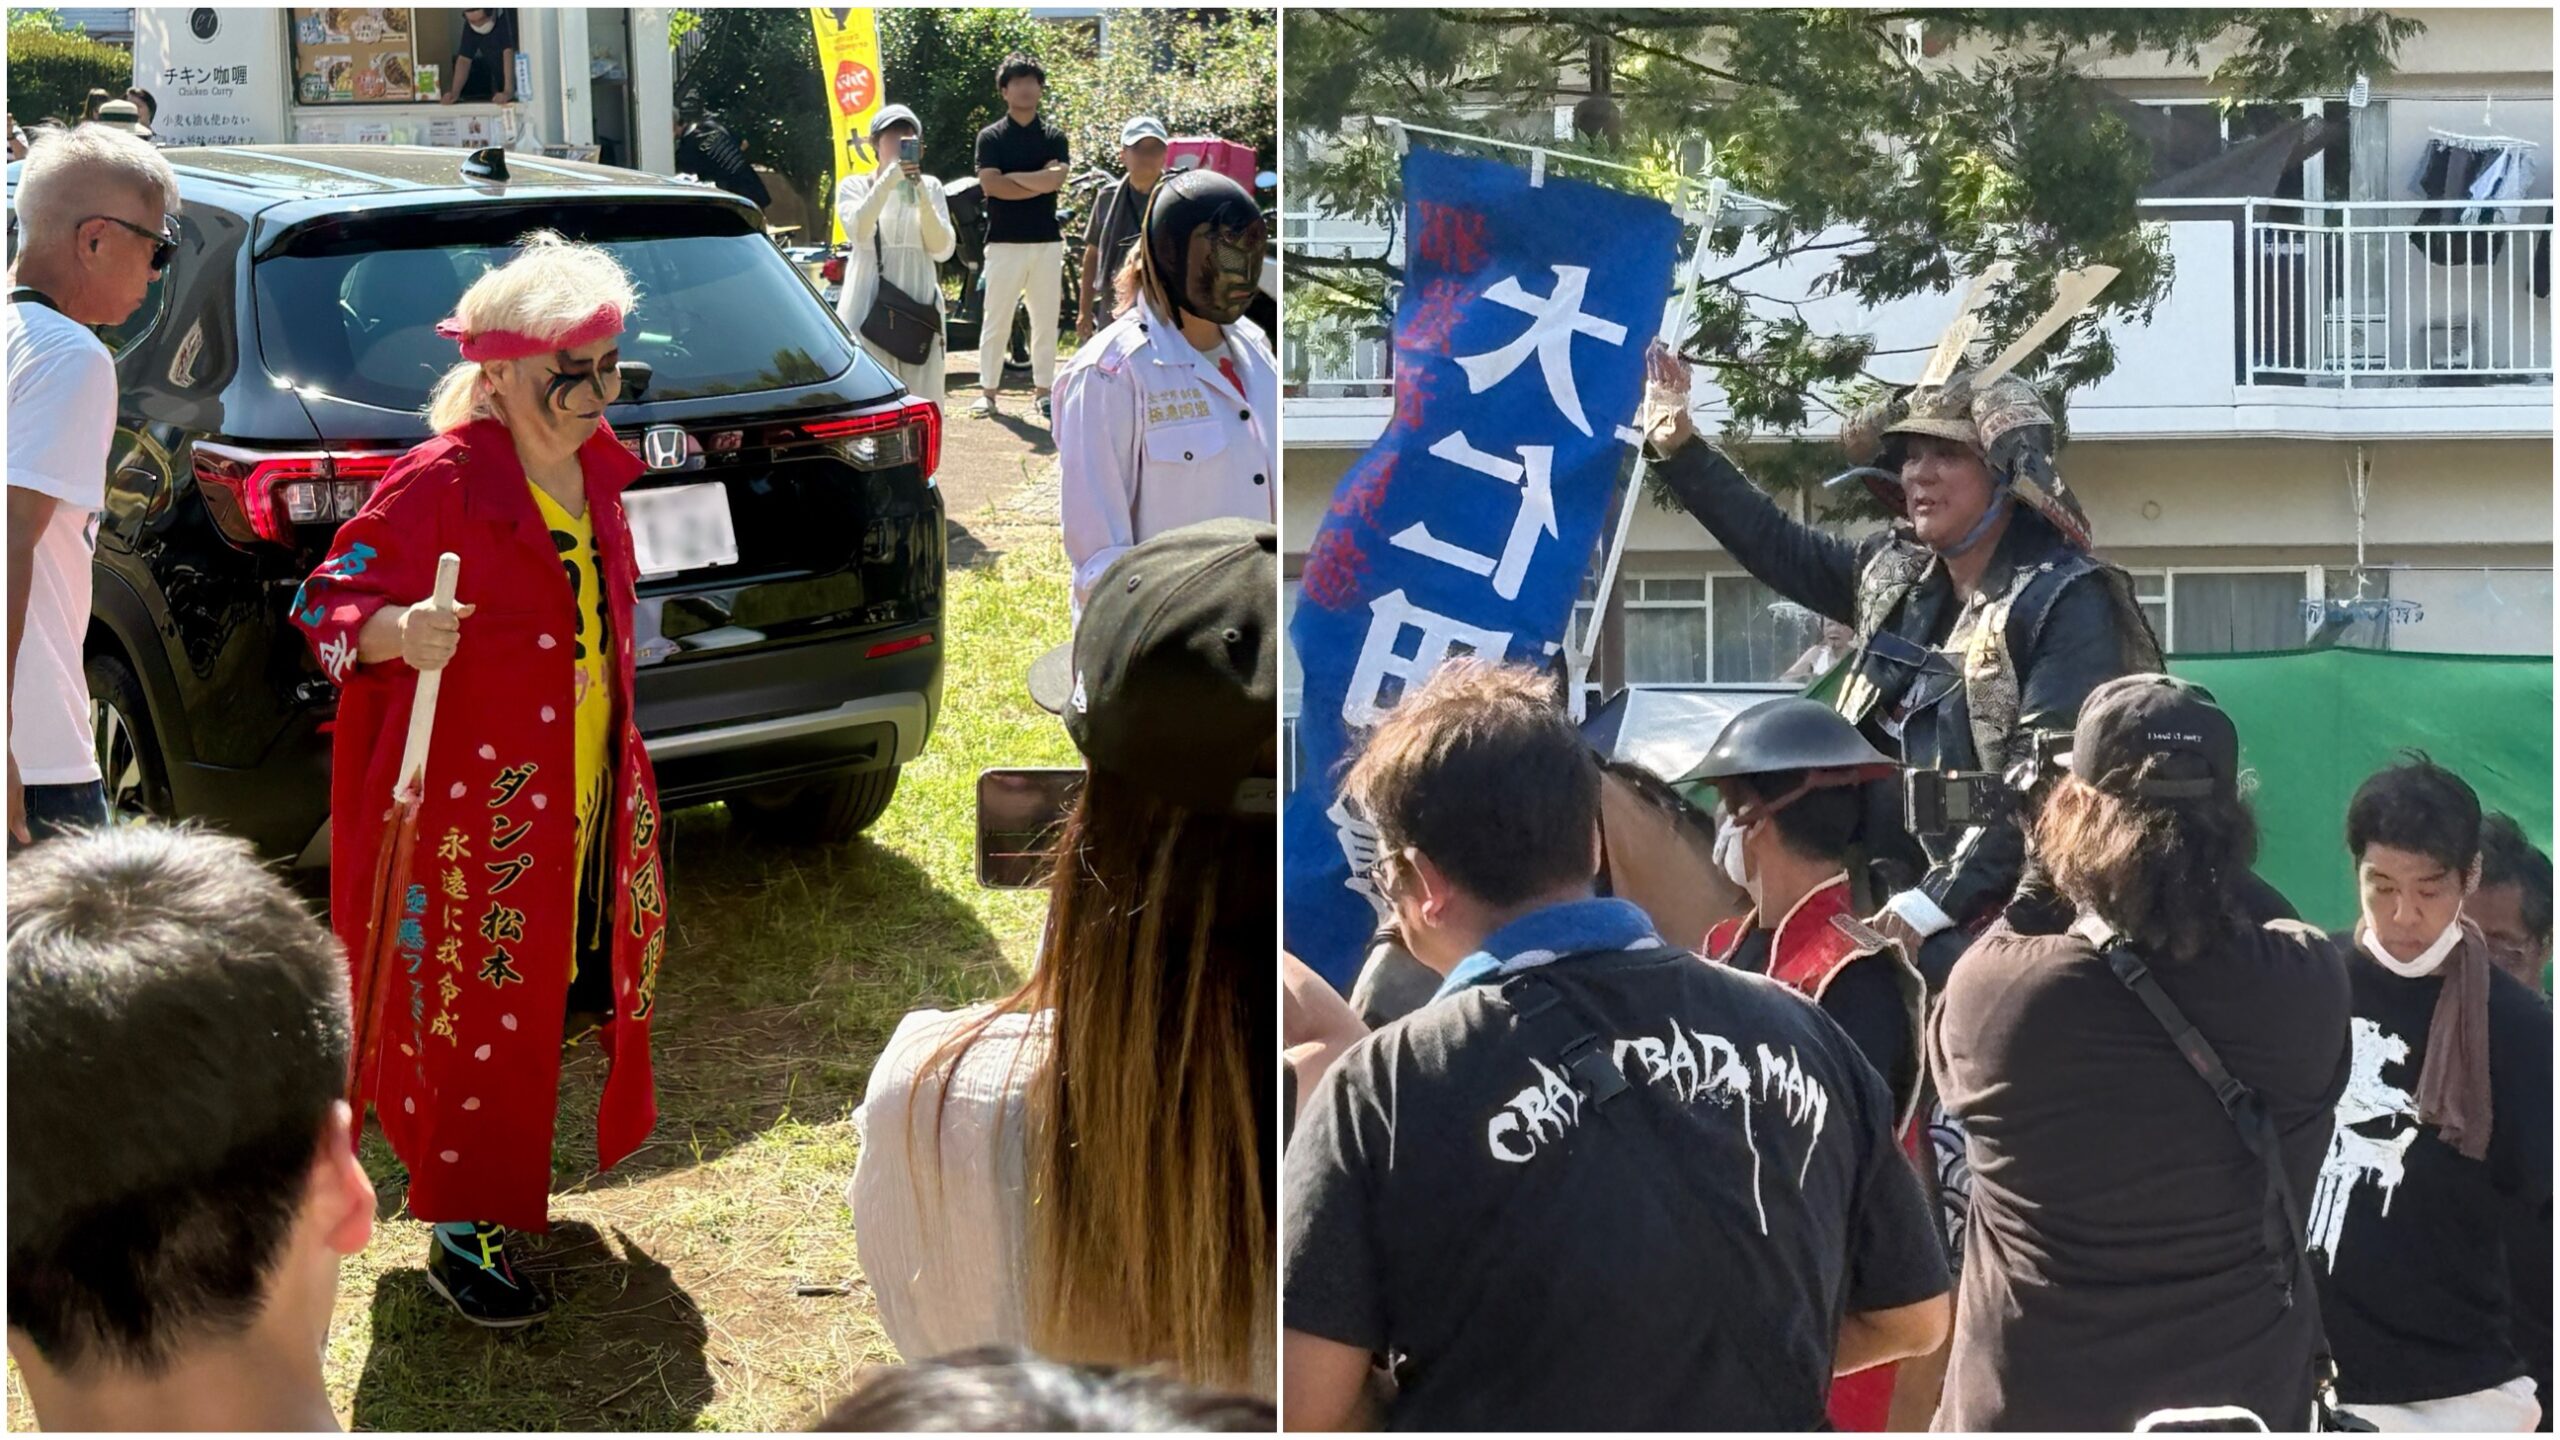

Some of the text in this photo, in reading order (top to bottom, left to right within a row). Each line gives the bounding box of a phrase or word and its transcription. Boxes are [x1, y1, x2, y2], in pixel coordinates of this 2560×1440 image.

[179, 87, 234, 98] Chicken Curry
[478, 762, 540, 989] ダンプ松本
[1630, 1017, 1751, 1104] BAD
[1756, 1043, 1829, 1150] MAN
